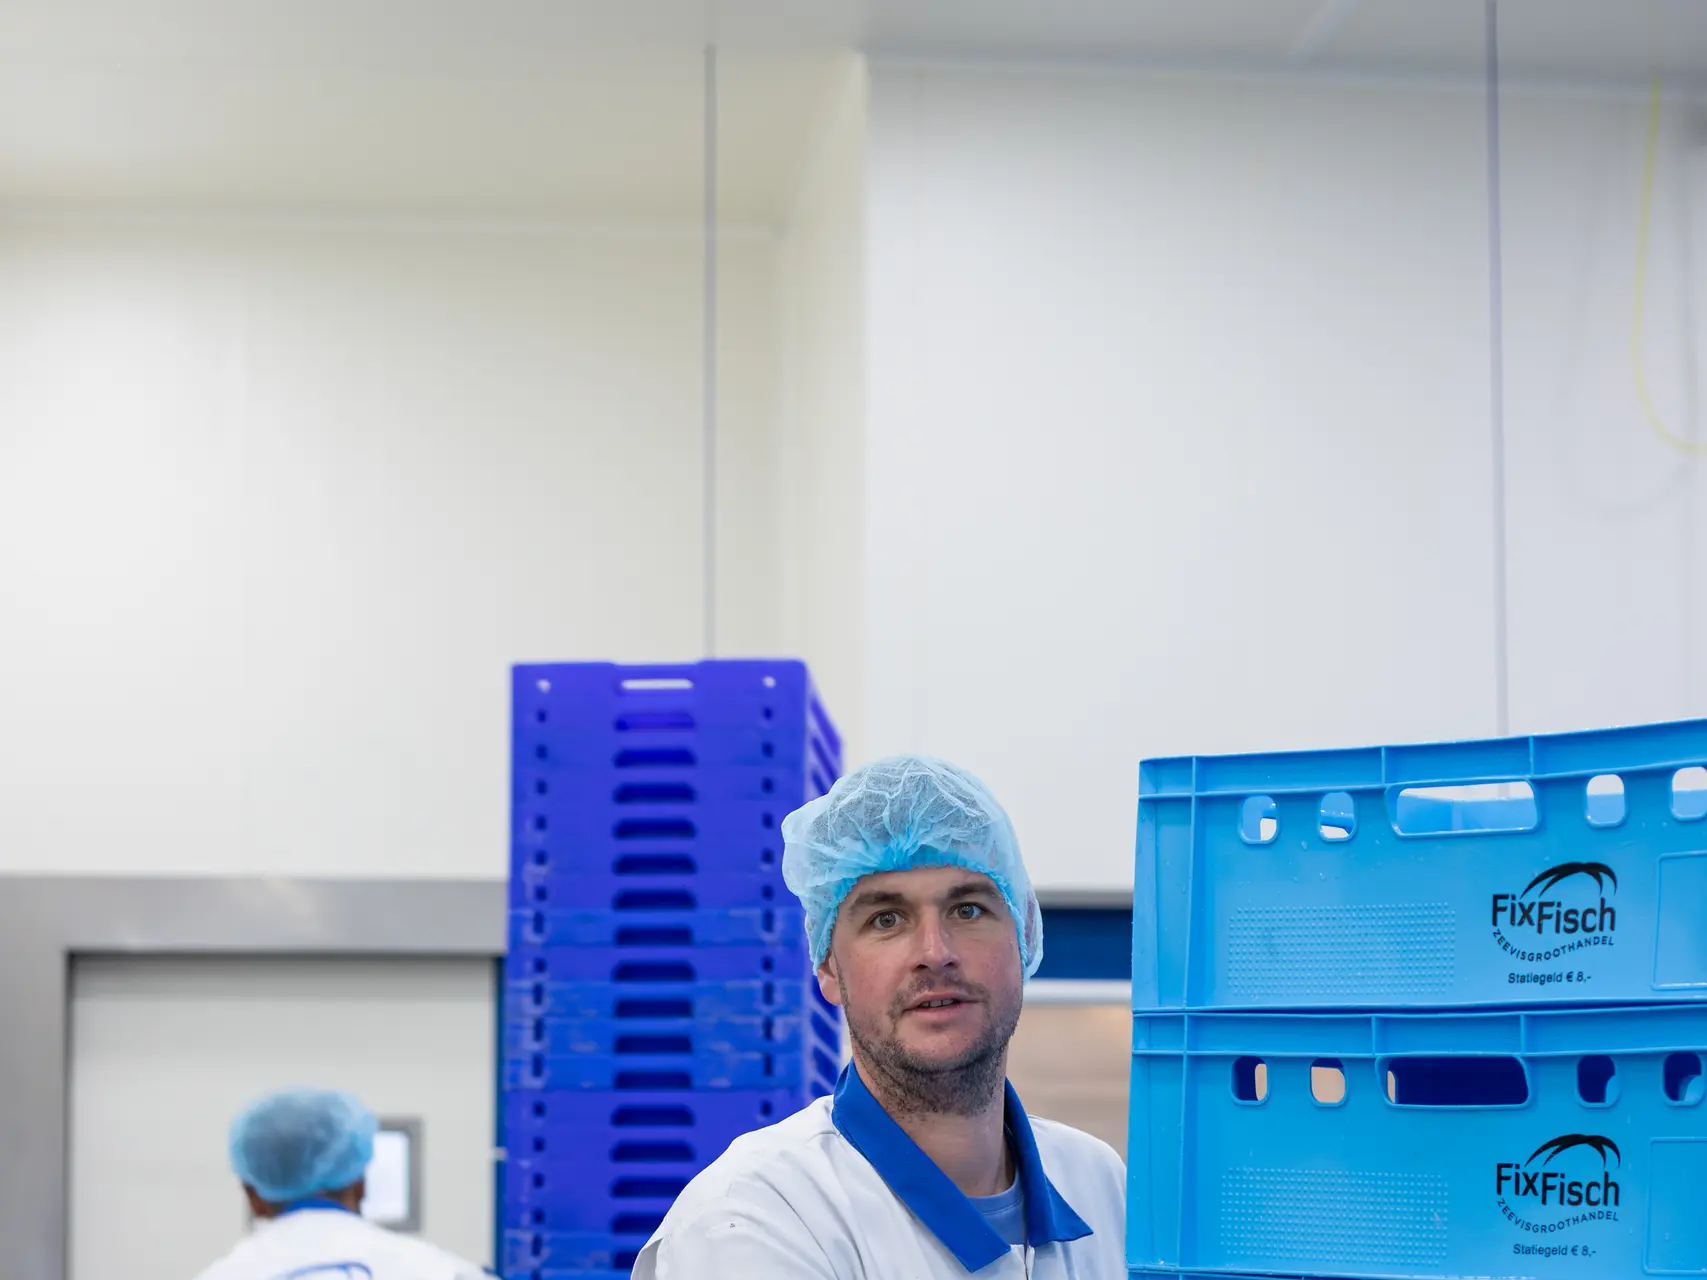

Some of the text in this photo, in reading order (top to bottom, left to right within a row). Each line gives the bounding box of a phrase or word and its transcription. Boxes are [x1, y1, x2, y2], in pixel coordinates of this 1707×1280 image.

[1492, 893, 1616, 934] FixFisch
[1492, 928, 1615, 962] ZEEVISGROOTHANDEL
[1508, 972, 1563, 985] Statiegeld
[1496, 1163, 1620, 1207] FixFisch
[1497, 1198, 1619, 1234] ZEEVISGROOTHANDEL
[1513, 1243, 1567, 1257] Statiegeld
